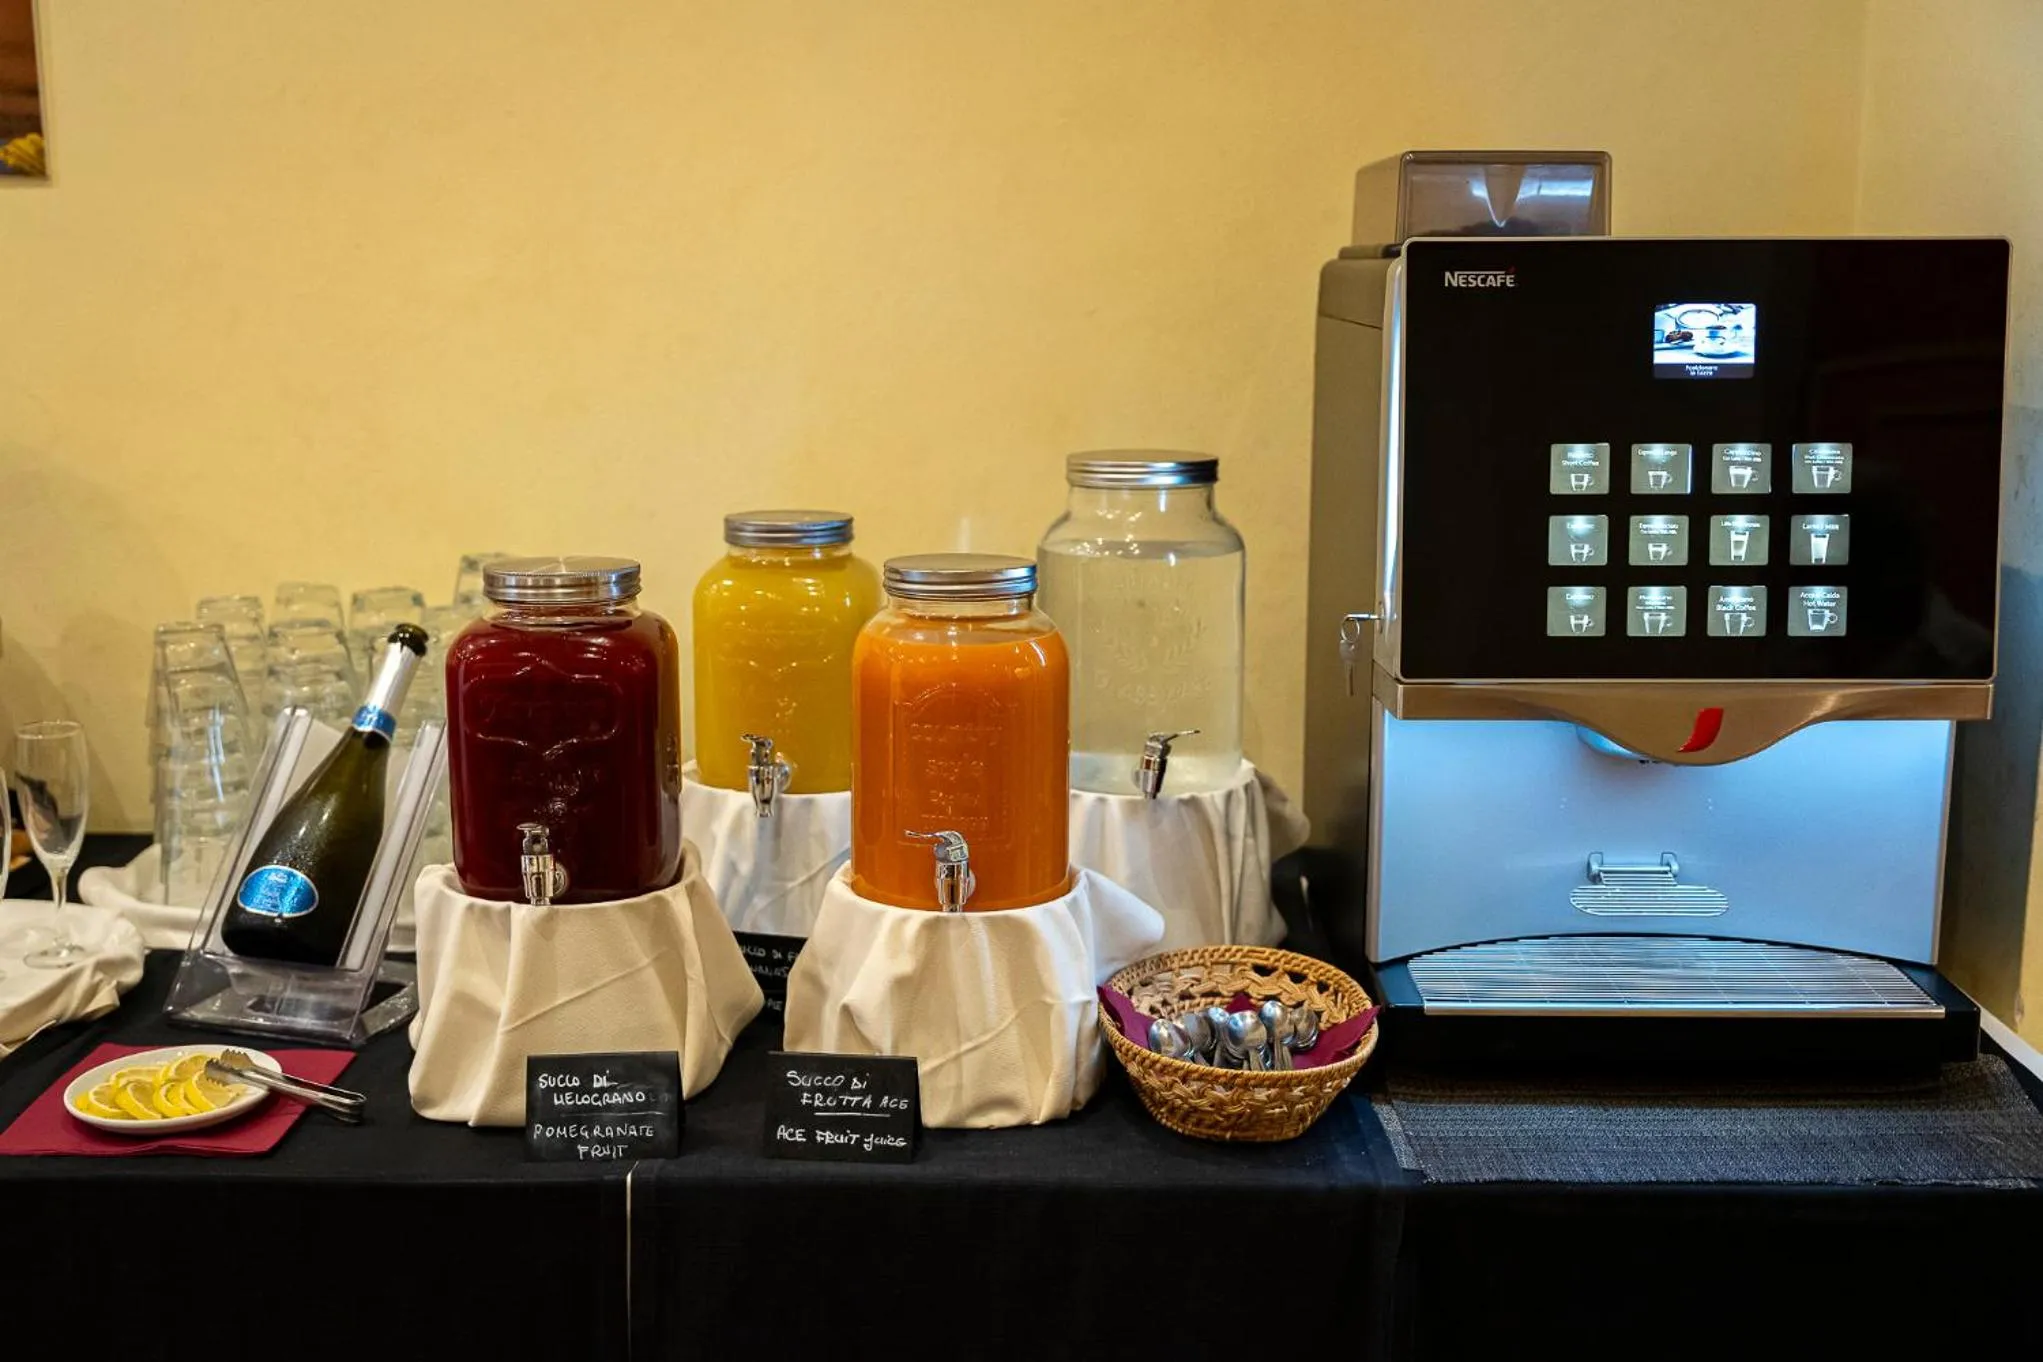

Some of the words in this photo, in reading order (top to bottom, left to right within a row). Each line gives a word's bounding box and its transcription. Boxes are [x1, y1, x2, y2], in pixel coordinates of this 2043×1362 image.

[538, 1073, 580, 1089] SUCCO
[786, 1070, 845, 1087] SUCCO
[533, 1122, 654, 1140] POMEGRANATE
[776, 1124, 807, 1142] ACE
[576, 1144, 629, 1160] FRUIT
